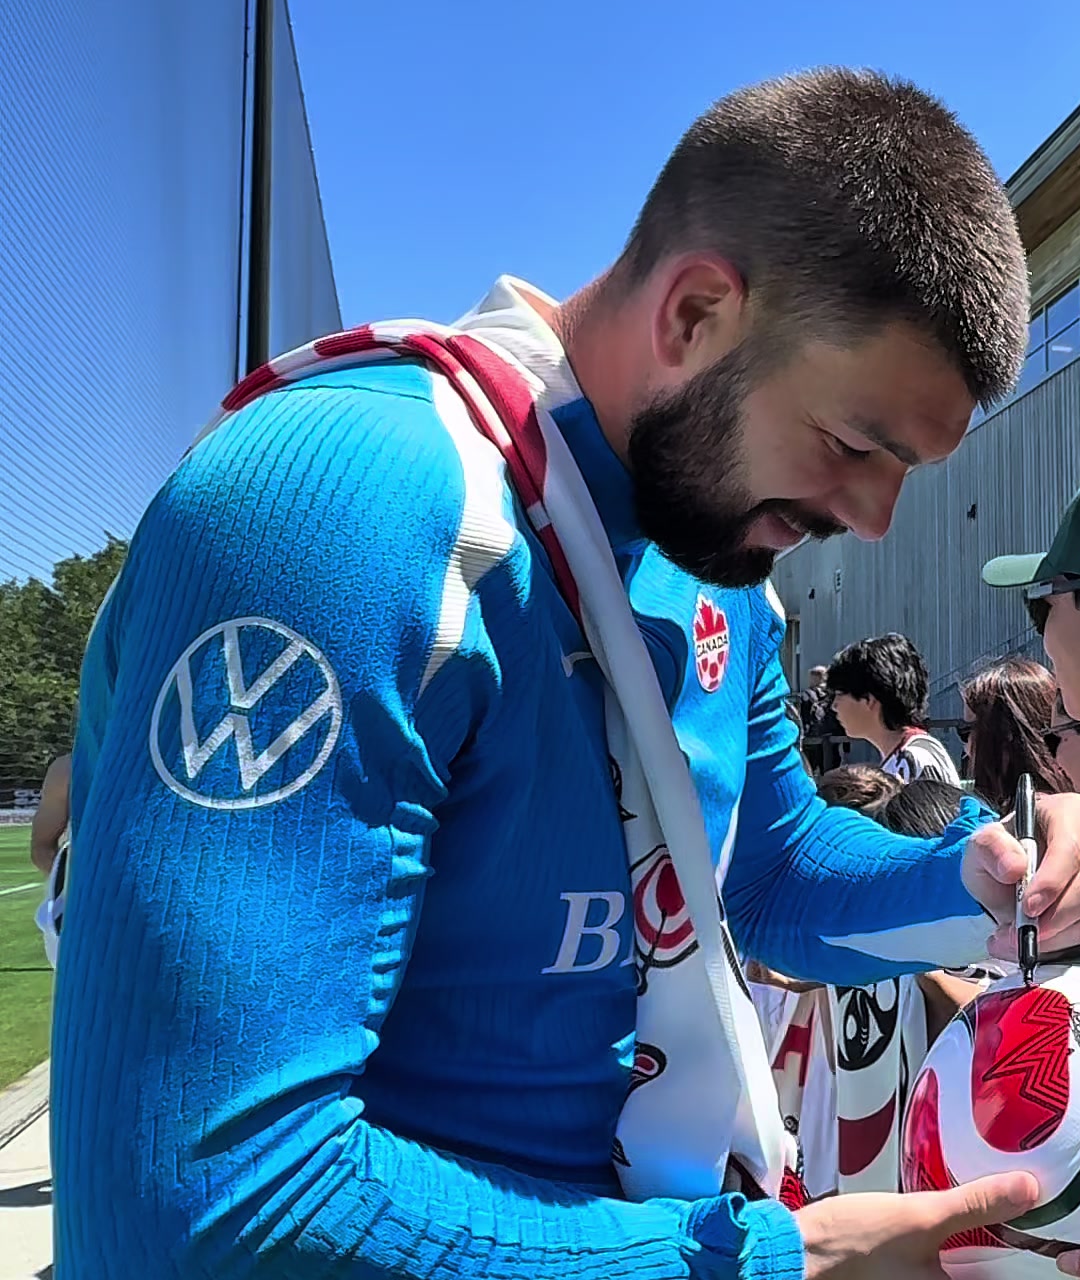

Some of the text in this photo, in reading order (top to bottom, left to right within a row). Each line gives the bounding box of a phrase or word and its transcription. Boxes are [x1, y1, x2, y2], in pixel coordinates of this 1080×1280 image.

[696, 633, 728, 658] CANADA
[174, 623, 337, 790] VW
[541, 890, 635, 975] B
